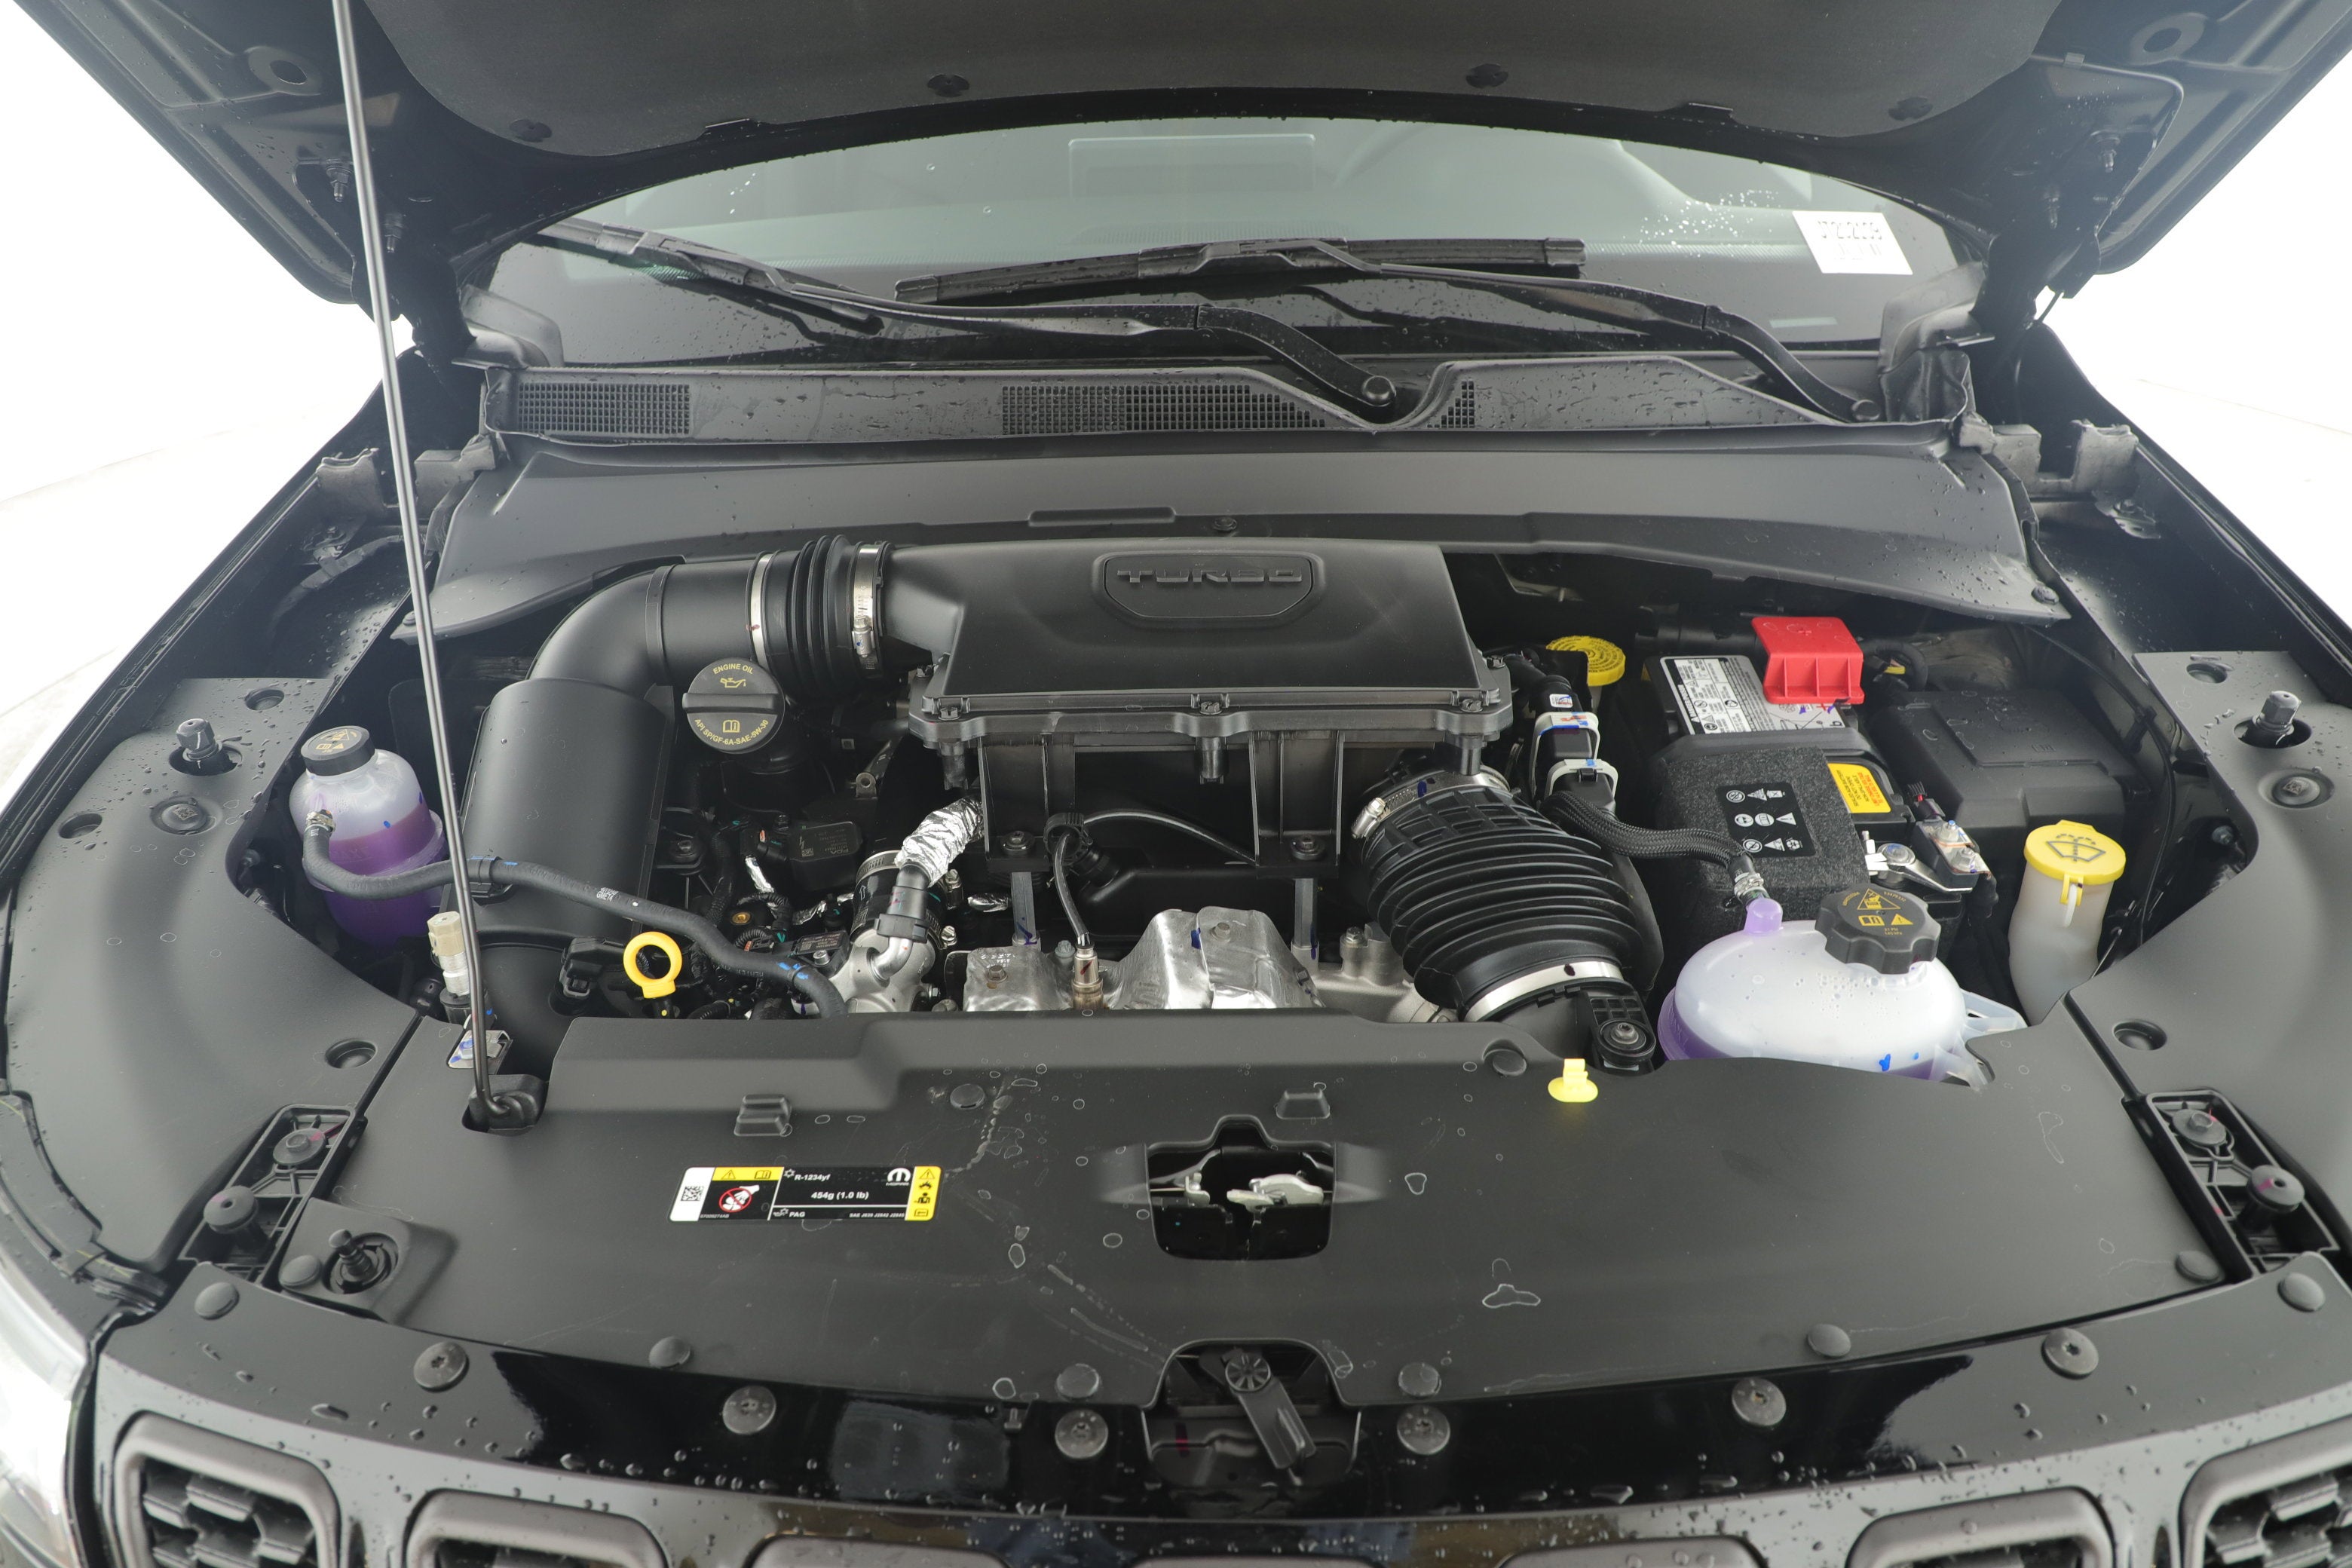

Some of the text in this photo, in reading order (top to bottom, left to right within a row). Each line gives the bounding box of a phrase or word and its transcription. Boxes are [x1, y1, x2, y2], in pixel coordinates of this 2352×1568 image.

[712, 663, 754, 675] ENGINE OIL
[694, 718, 704, 732] API
[795, 1174, 831, 1182] R-1234yf
[811, 1191, 869, 1200] 454g (1.0 lb)
